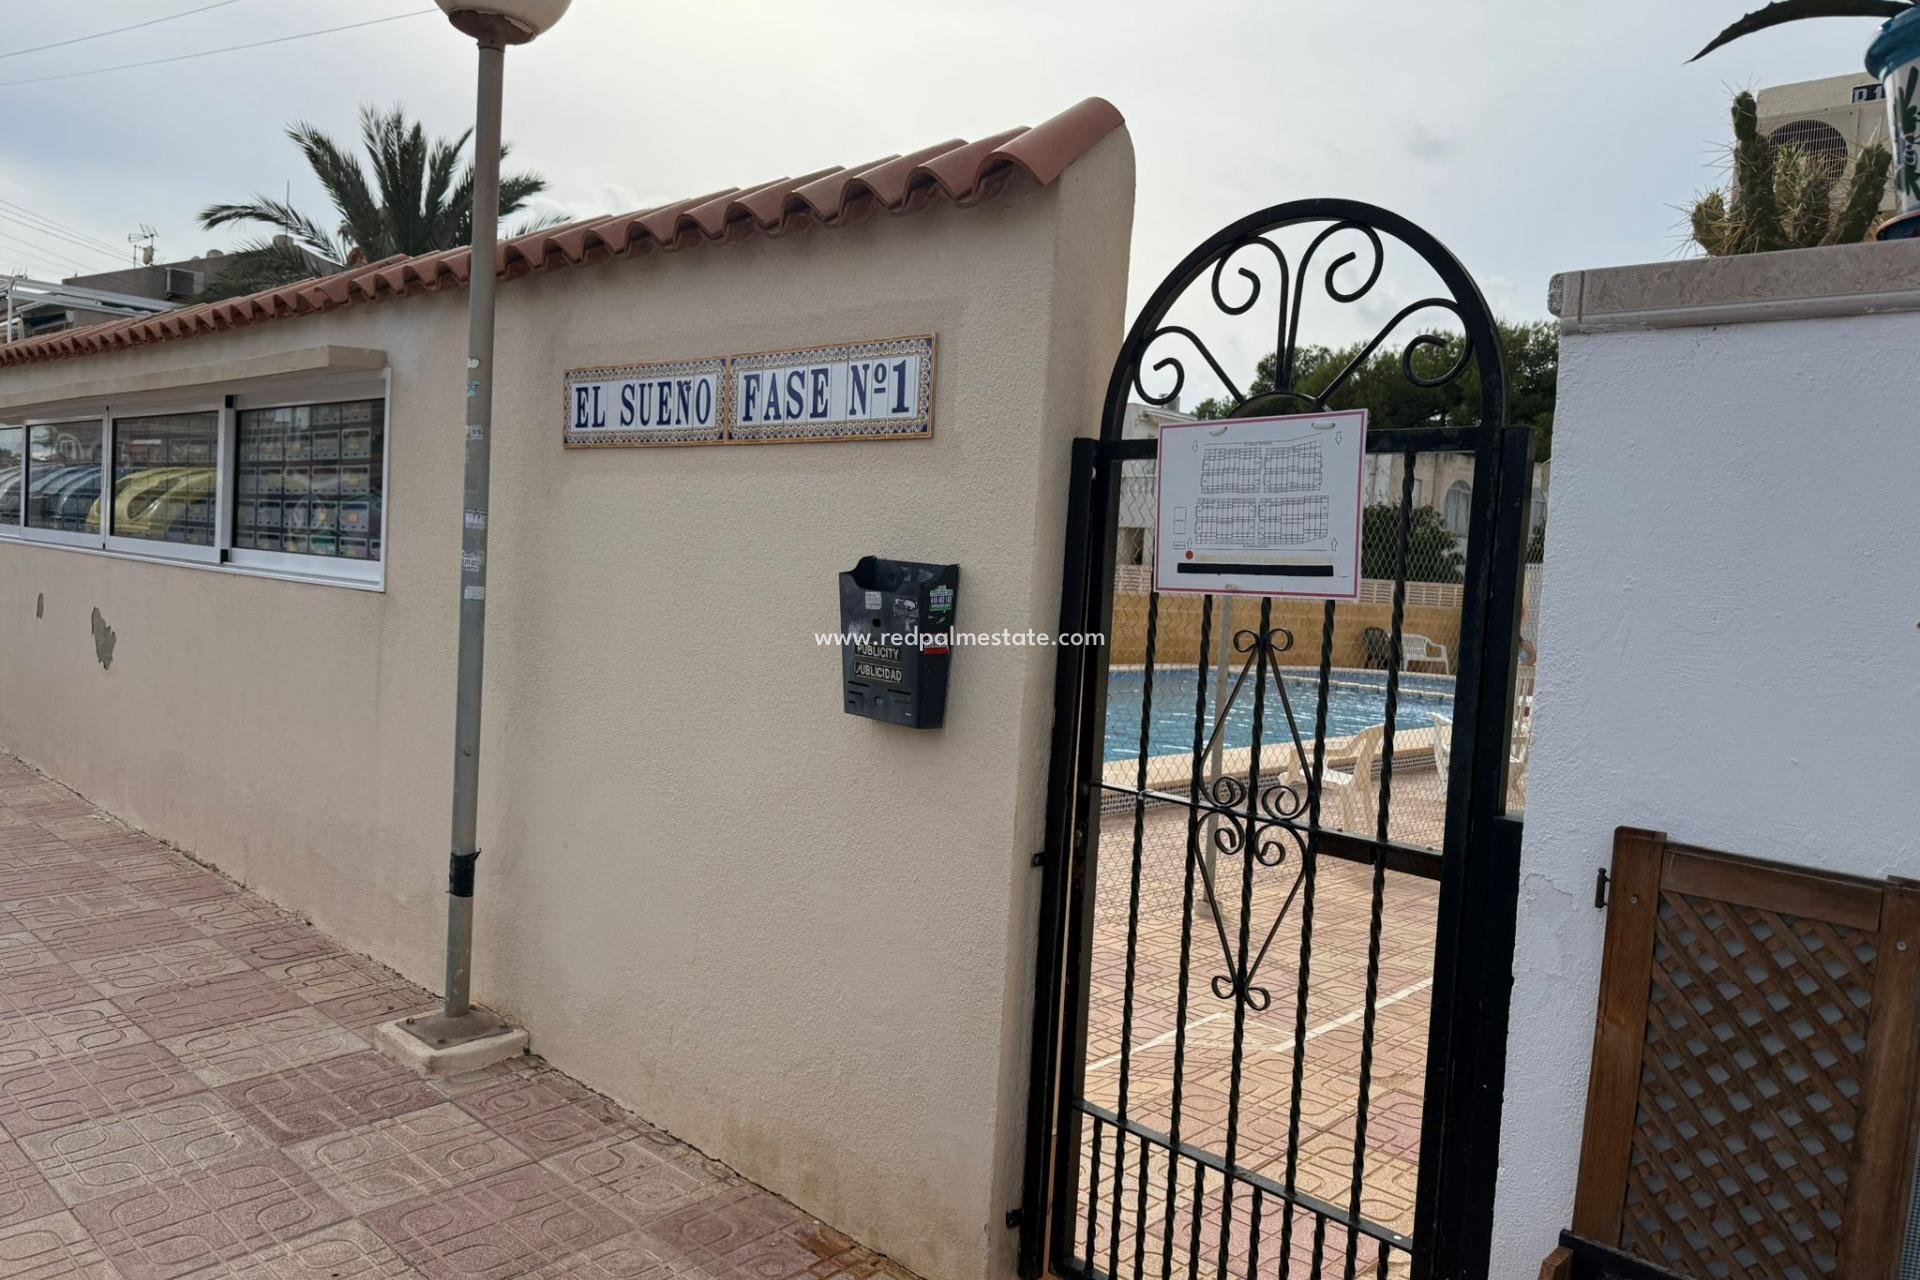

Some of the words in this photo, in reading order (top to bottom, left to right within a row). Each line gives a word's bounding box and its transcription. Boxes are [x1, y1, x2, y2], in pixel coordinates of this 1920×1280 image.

[575, 386, 605, 428] EL
[620, 378, 711, 426] SUEÑO
[742, 368, 829, 422] FASE
[857, 643, 899, 660] PUBLICITY
